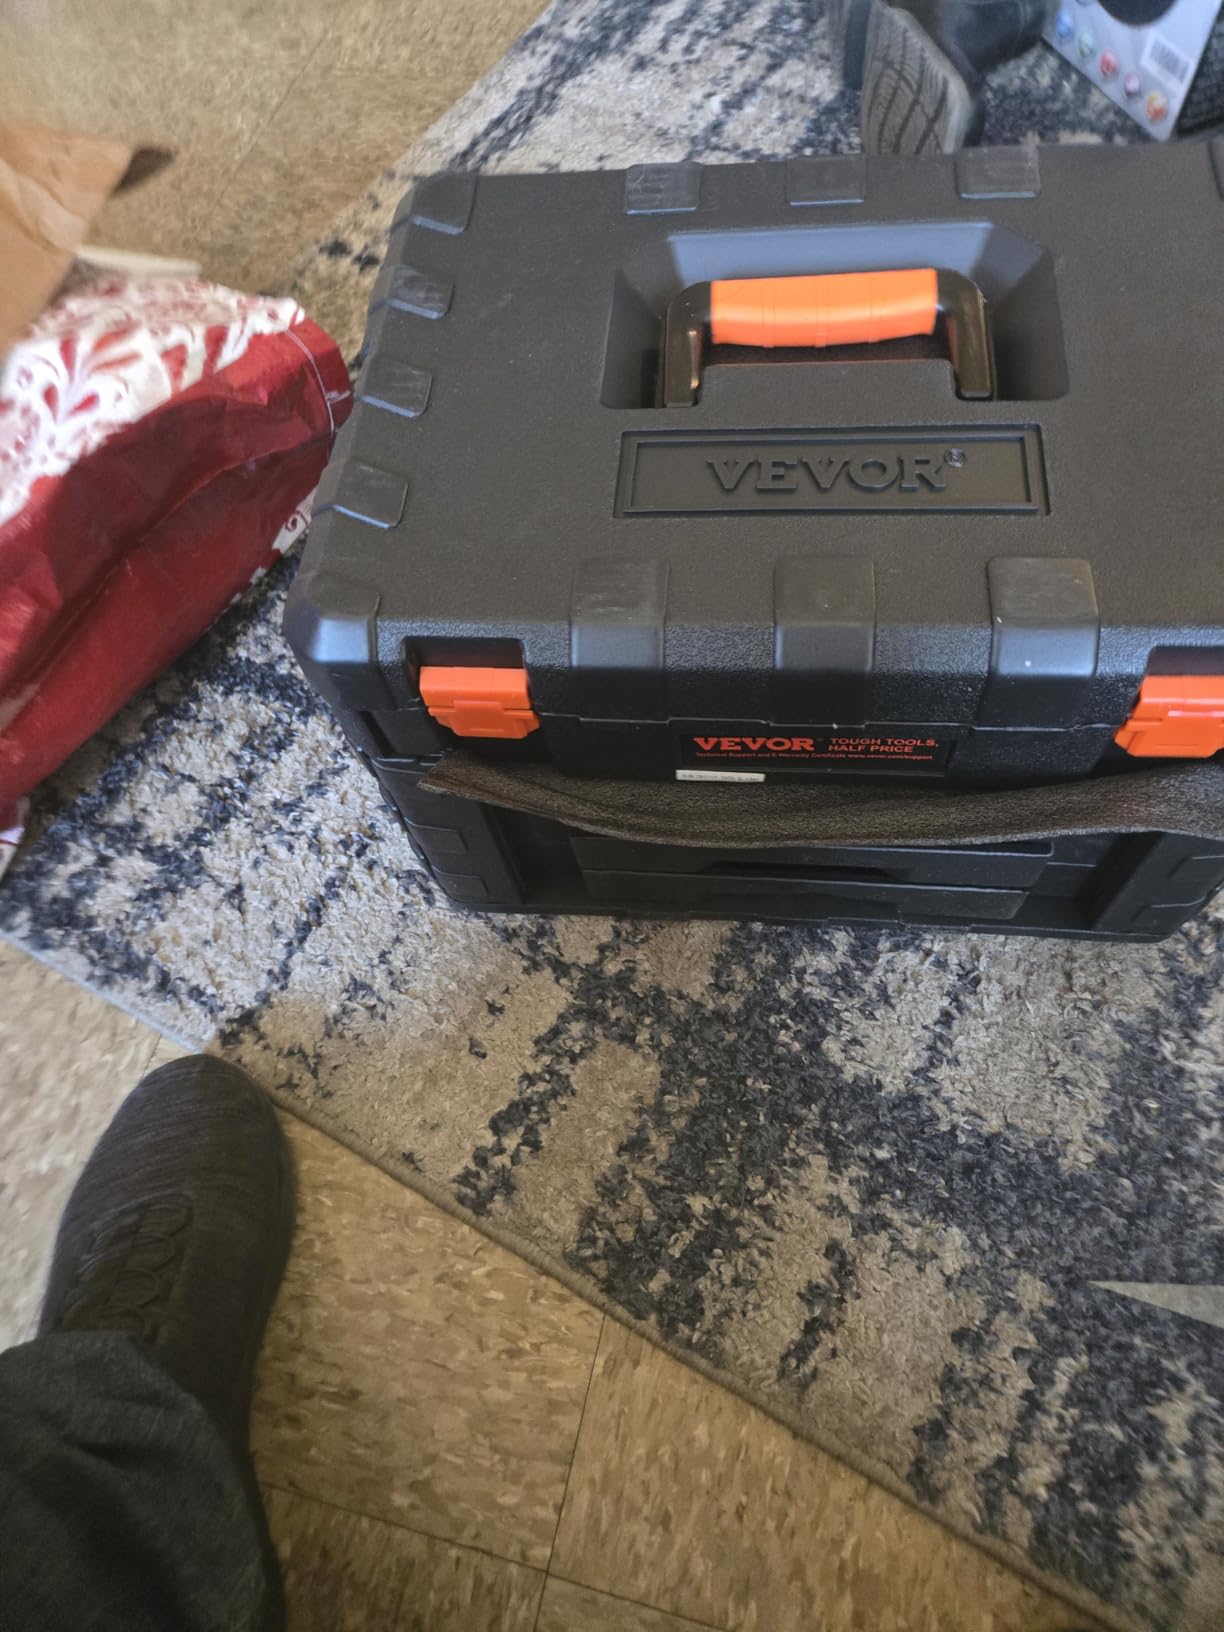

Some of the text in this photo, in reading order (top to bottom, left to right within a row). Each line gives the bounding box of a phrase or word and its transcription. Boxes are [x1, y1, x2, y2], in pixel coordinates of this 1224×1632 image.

[693, 737, 815, 751] VEVOR
[885, 738, 940, 748] TOOLS,
[870, 745, 914, 753] PRICE
